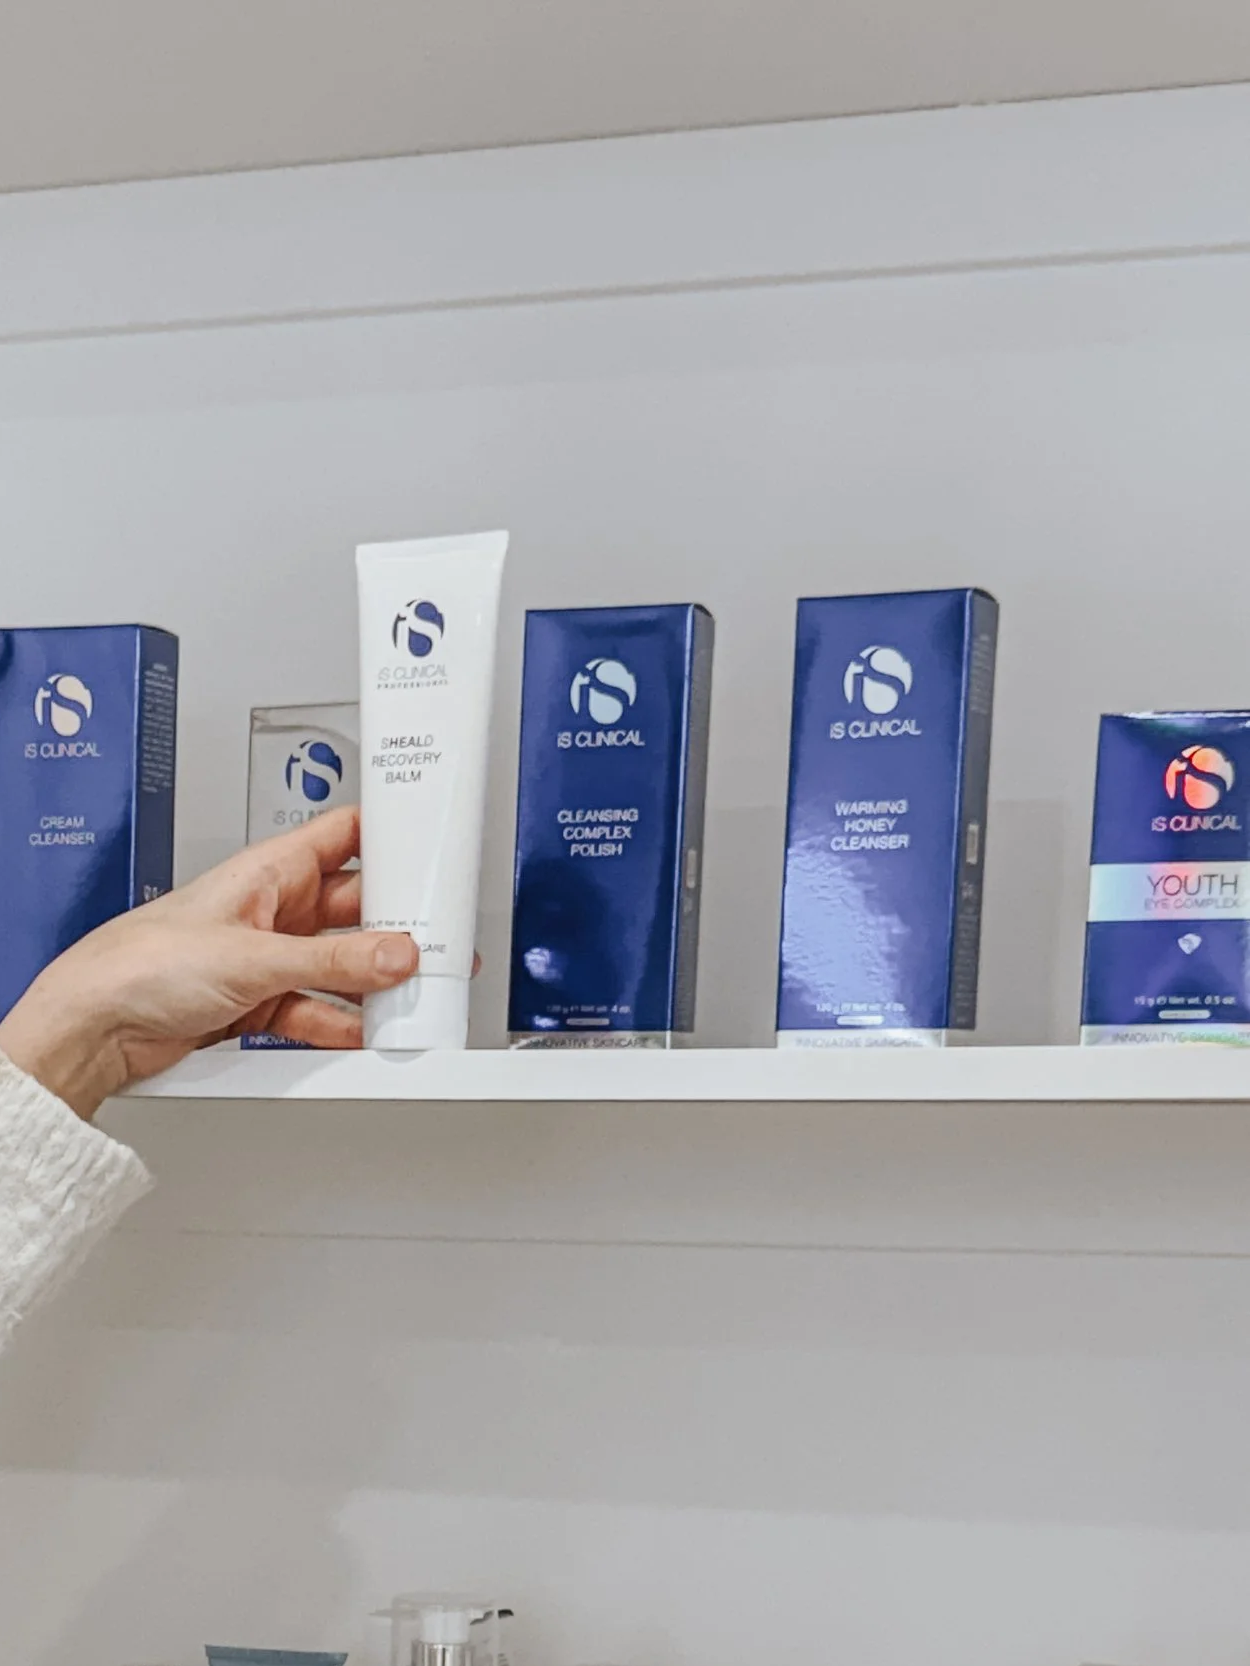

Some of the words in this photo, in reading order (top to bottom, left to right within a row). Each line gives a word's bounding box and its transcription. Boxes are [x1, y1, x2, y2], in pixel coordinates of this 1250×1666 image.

[393, 664, 448, 681] CLINICAL
[848, 719, 923, 739] CLINICAL
[380, 734, 435, 751] SHEALD
[575, 730, 646, 748] CLINICAL
[40, 742, 102, 758] CLINICAL
[371, 751, 442, 768] RECOVERY
[385, 770, 422, 785] BALM
[835, 799, 908, 816] WARMING
[39, 816, 85, 829] CREAM
[557, 808, 639, 824] CLEANSING
[1169, 815, 1242, 831] CLINICAL
[562, 825, 633, 841] COMPLEX
[844, 818, 898, 833] HONEY
[29, 832, 95, 846] CLEANSER
[830, 834, 910, 851] CLEANSER
[570, 843, 623, 857] POLISH
[1147, 874, 1239, 896] YOUTH
[1144, 898, 1170, 911] EYE
[1173, 897, 1245, 910] COMPLEX
